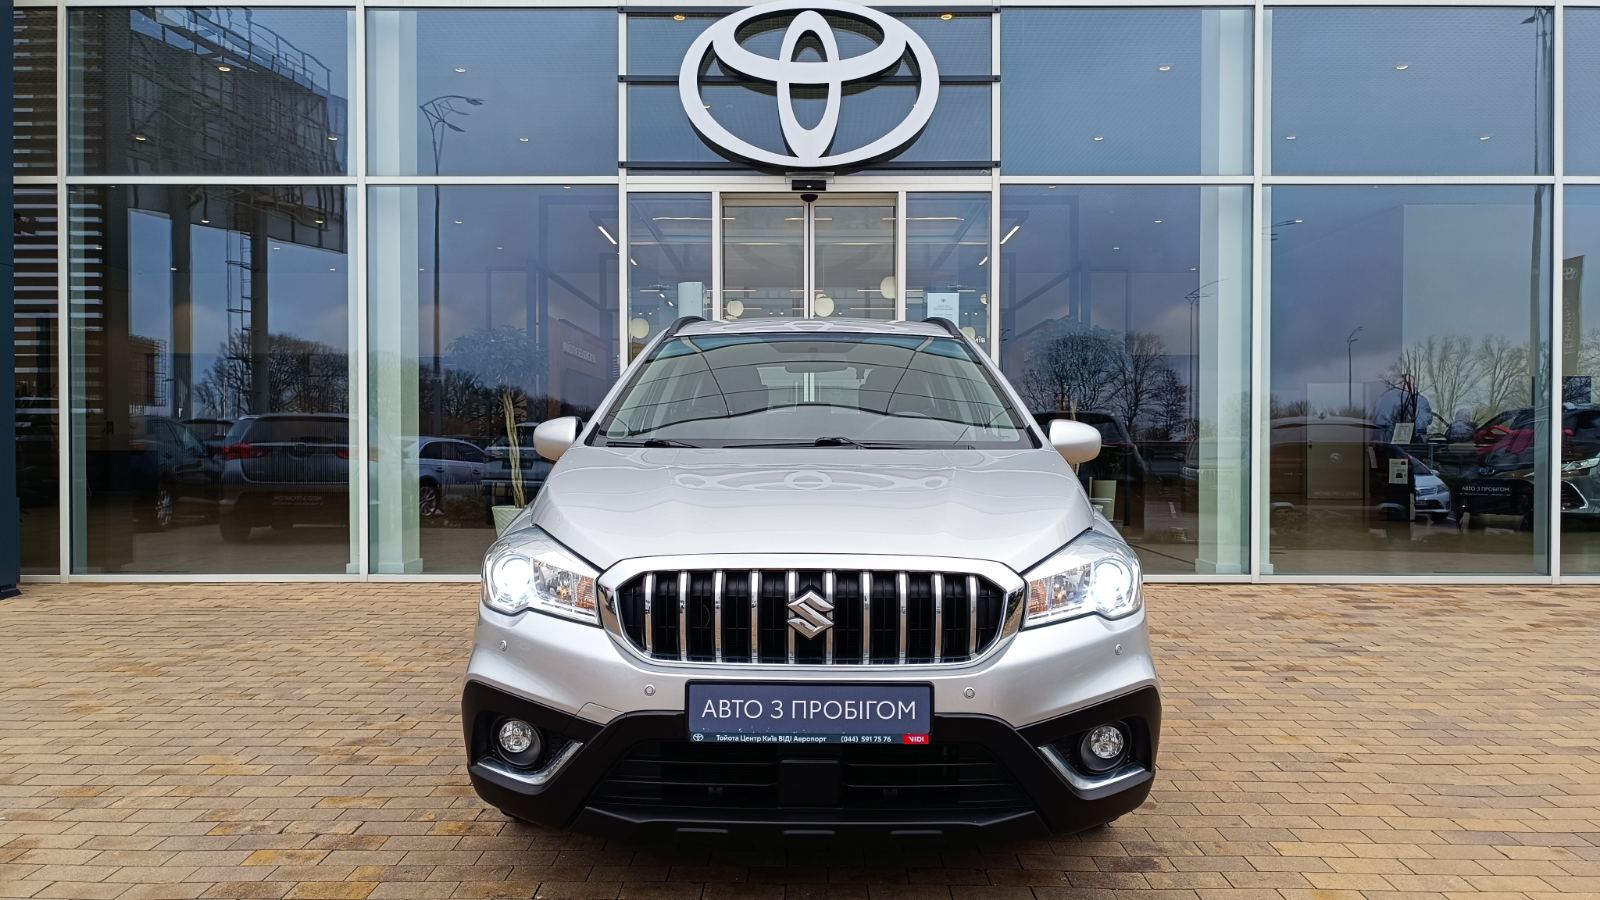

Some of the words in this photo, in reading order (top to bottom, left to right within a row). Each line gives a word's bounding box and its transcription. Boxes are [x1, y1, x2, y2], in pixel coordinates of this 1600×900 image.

[701, 699, 763, 719] АВТО
[770, 699, 783, 719] З
[791, 700, 916, 720] ПРОБІГОМ
[716, 734, 739, 742] Тойота
[740, 735, 761, 743] Центр
[793, 735, 827, 743] Аеропорт
[840, 735, 859, 743] (044)
